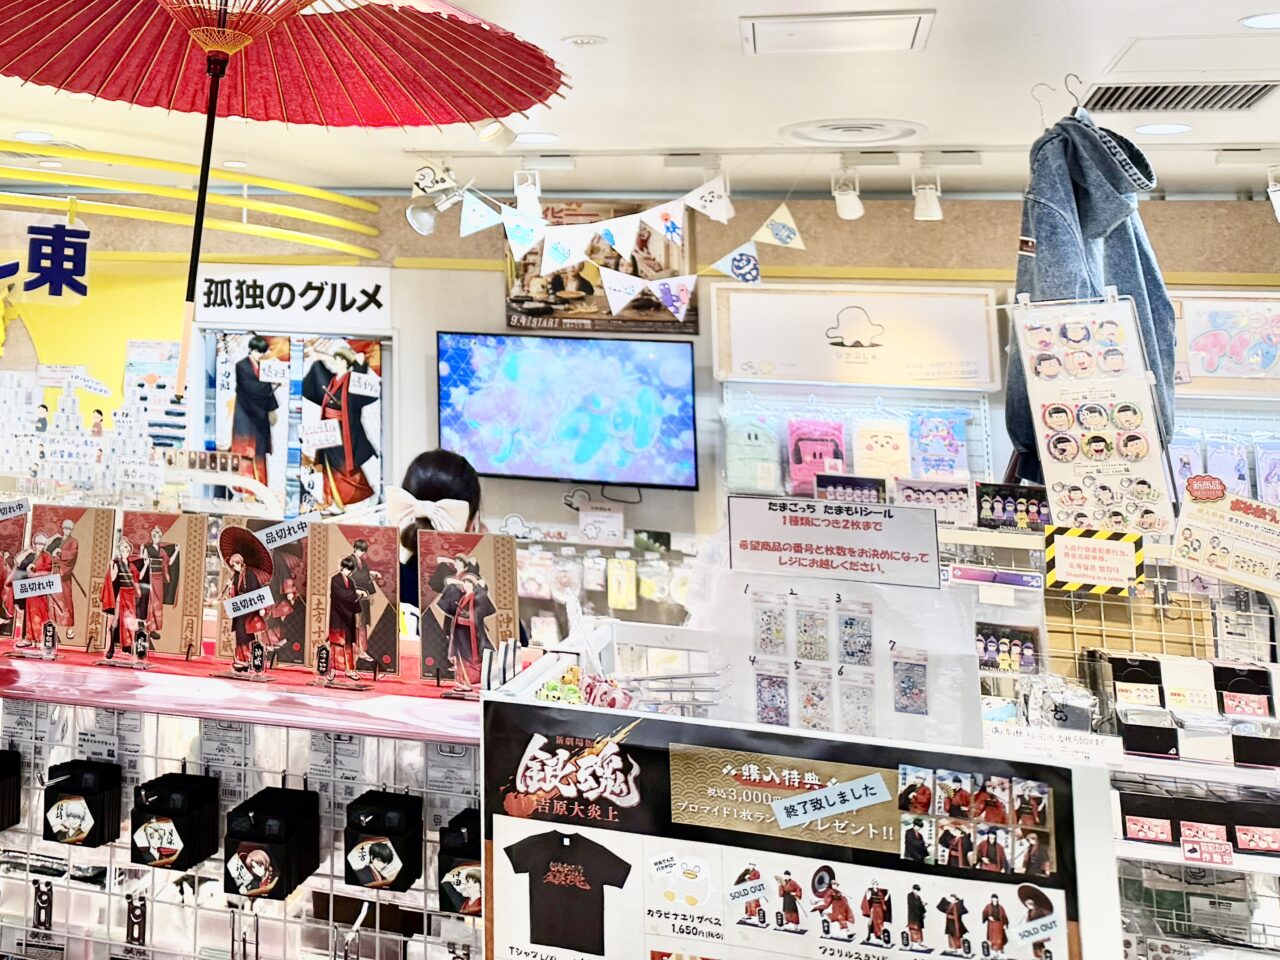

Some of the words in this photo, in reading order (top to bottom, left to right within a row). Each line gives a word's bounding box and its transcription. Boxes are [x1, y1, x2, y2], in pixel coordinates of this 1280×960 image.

[202, 276, 385, 314] 孤独のグルメ
[531, 318, 560, 329] START
[767, 501, 816, 515] たまごっち
[823, 504, 894, 520] たまもりシール
[265, 520, 308, 545] 品切れ中
[781, 515, 883, 532] 1種類につき2枚まで
[738, 539, 930, 564] 希望商品の番号と枚数をお決めになって
[778, 555, 886, 575] レジにお越しください。
[19, 579, 55, 595] 品切れ中
[231, 593, 266, 613] 品切れ中
[516, 733, 641, 808] 銀魂
[741, 762, 822, 790] 購入特典
[536, 798, 620, 822] 吉原大炎上
[783, 782, 879, 820] 終了致しました
[729, 886, 749, 901] SOLD
[749, 882, 766, 896] OUT
[646, 909, 723, 927] カラビナエリザベス
[1017, 926, 1039, 941] SOLD
[1040, 919, 1058, 935] OUT
[508, 946, 539, 960] Tシャツ
